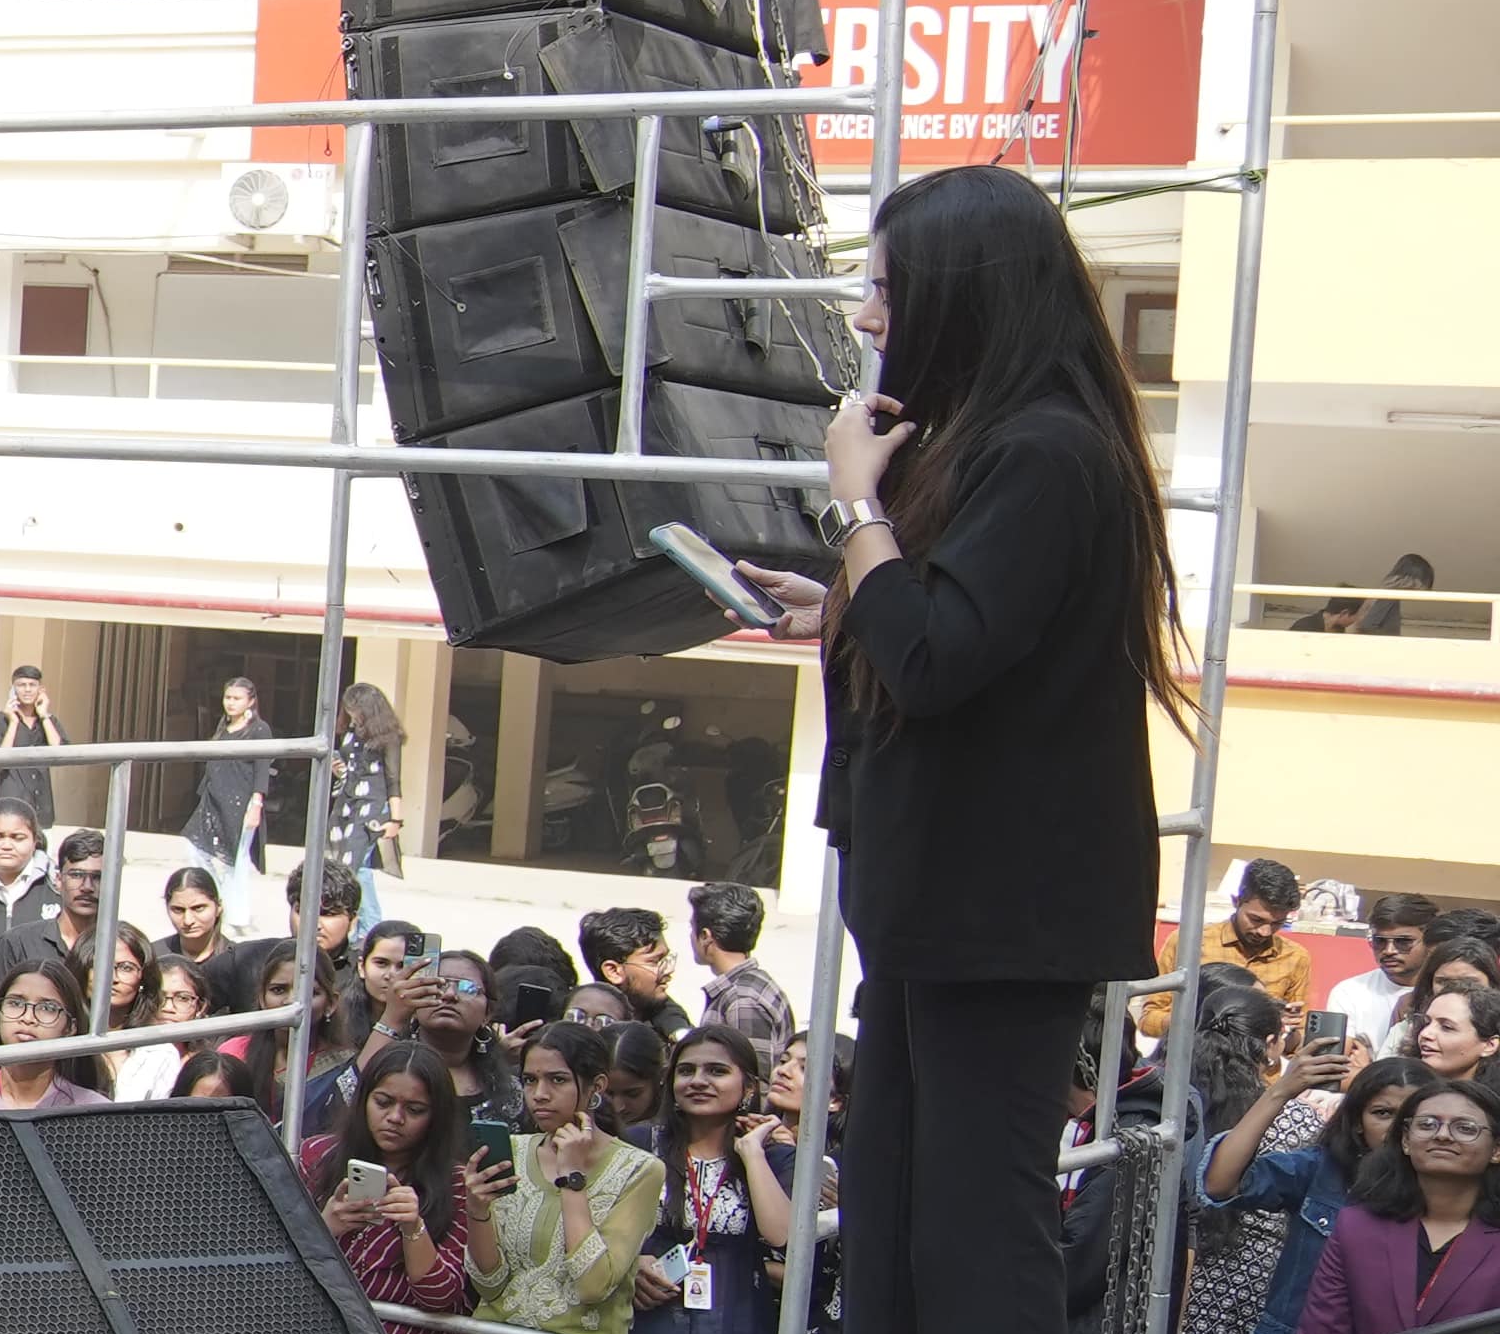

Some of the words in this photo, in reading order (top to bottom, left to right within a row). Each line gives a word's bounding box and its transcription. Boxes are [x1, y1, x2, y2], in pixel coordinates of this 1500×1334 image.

[791, 4, 1077, 107] RSITY
[815, 113, 946, 140] EXCELNCE
[948, 113, 979, 140] BY
[981, 112, 1060, 140] CHOCE
